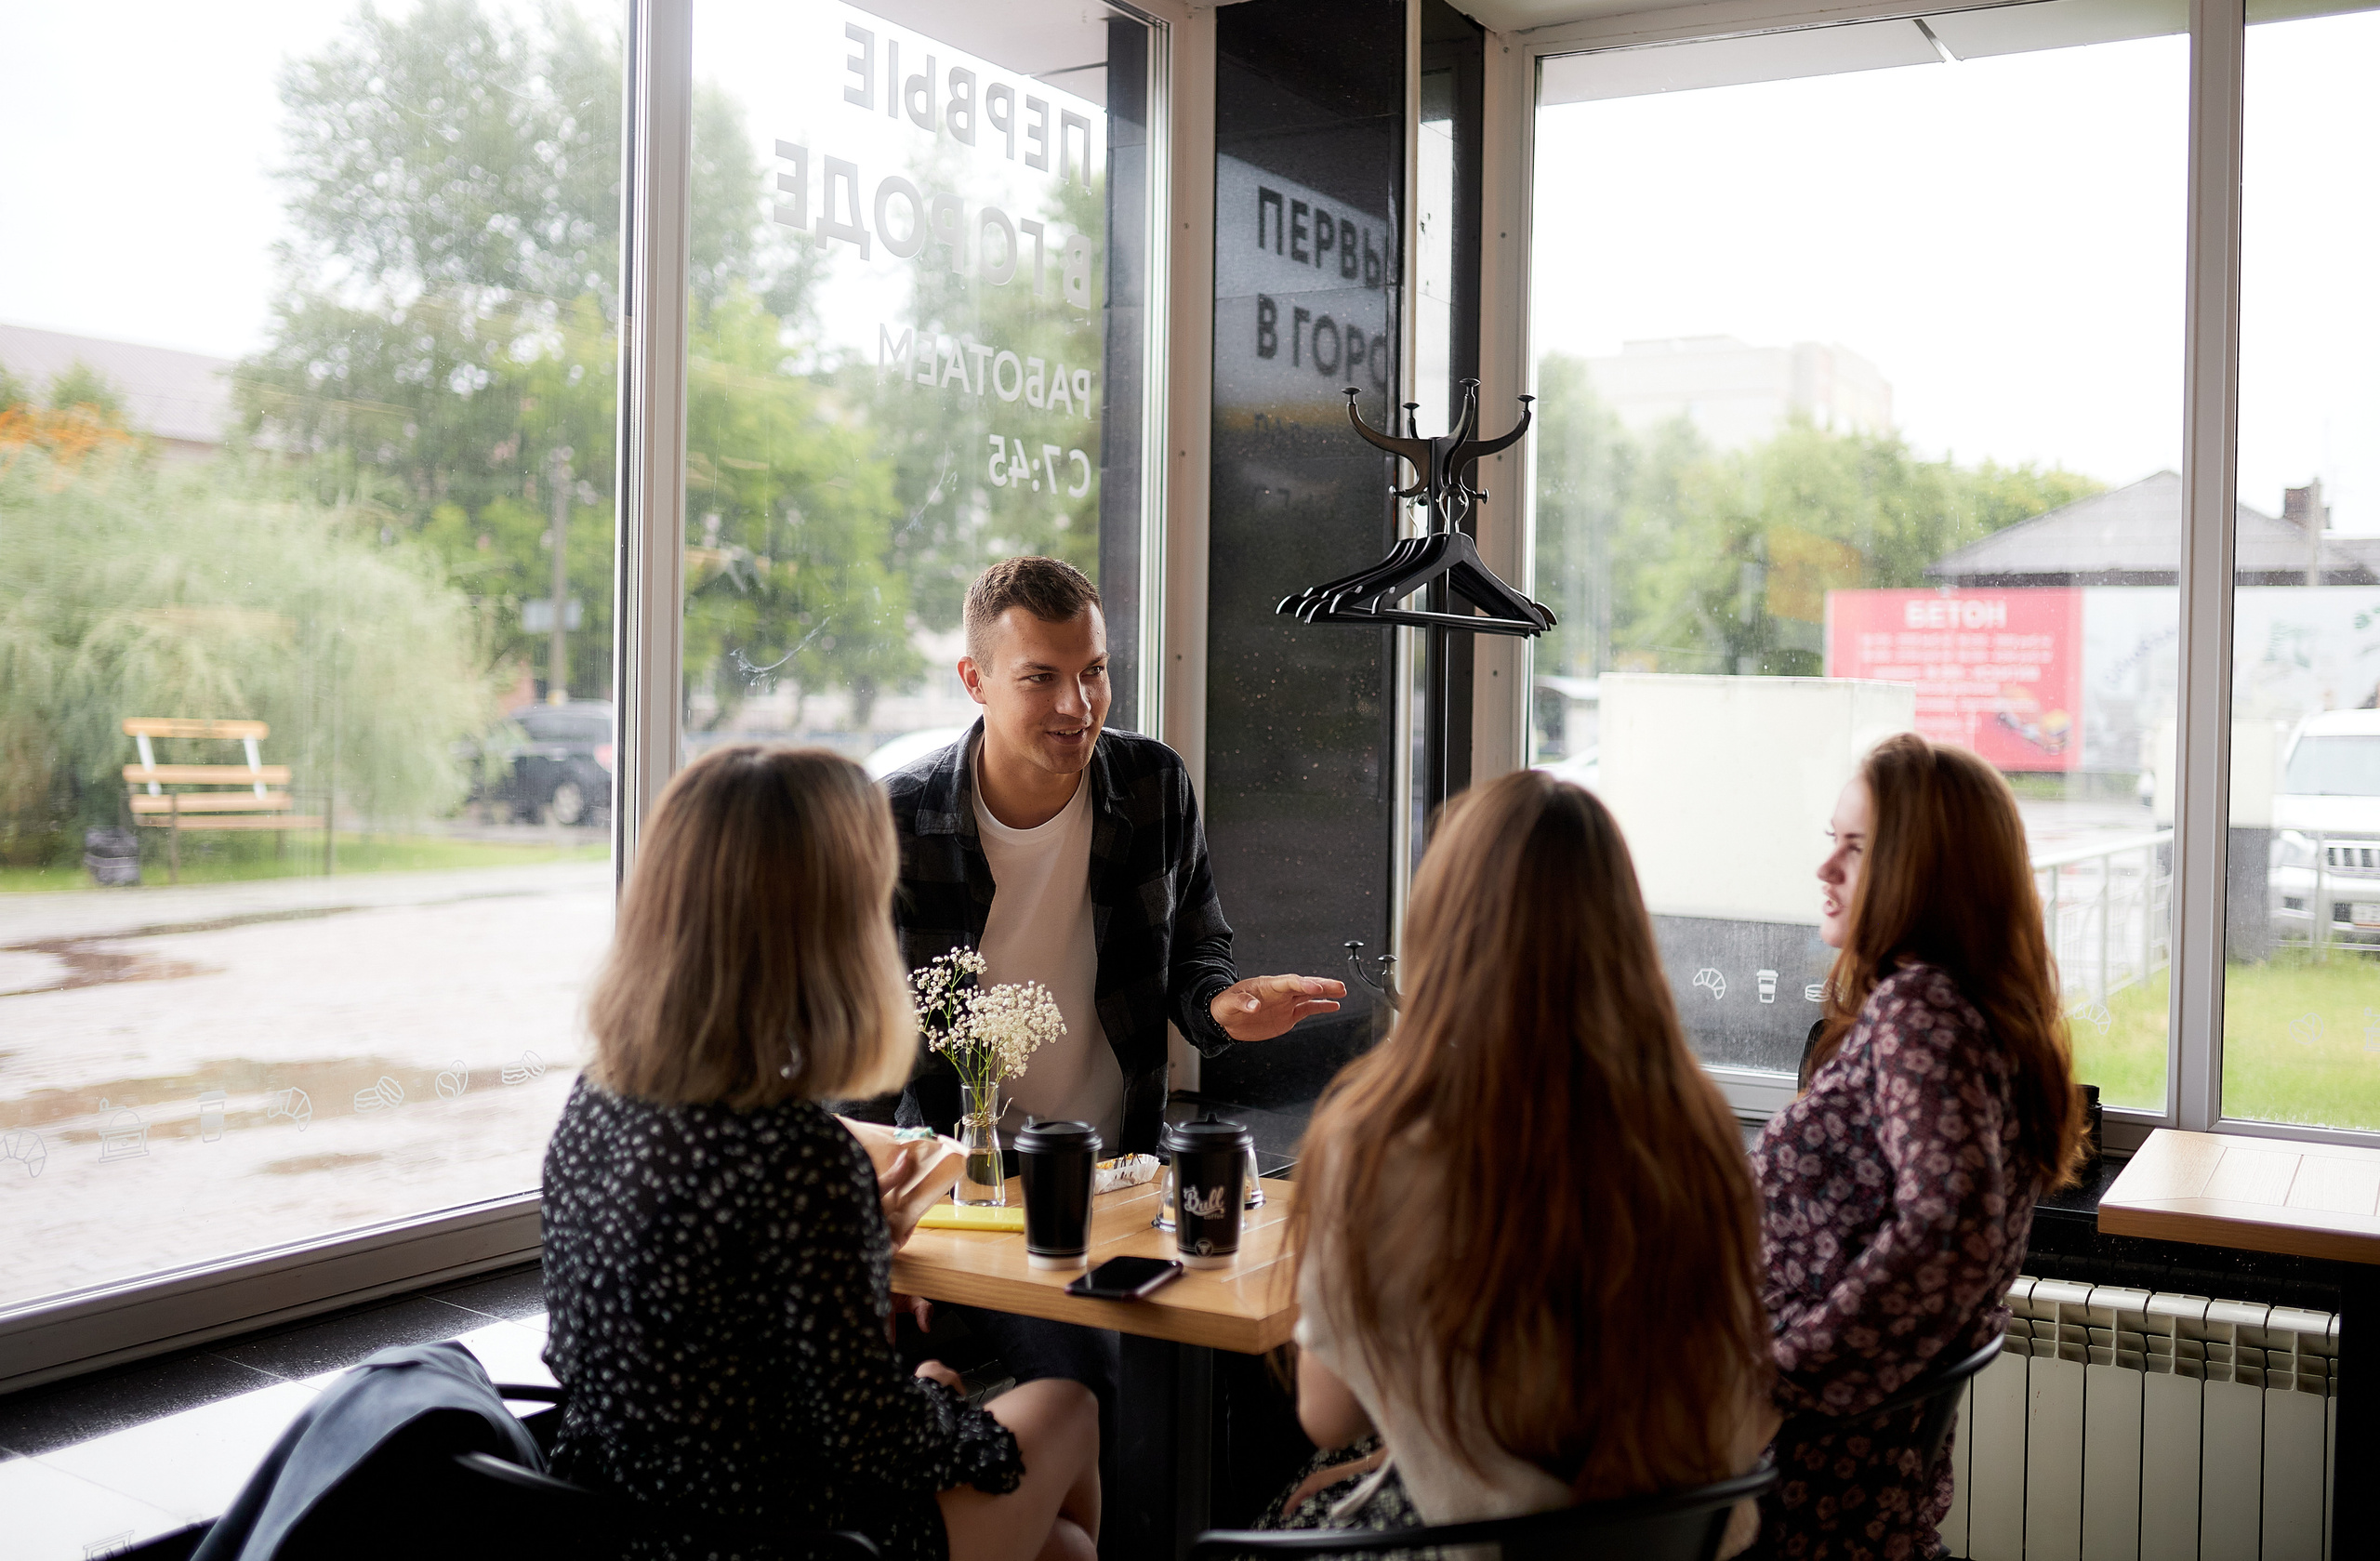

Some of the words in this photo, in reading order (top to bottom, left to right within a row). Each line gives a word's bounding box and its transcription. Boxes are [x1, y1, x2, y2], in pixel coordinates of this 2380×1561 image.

[1259, 186, 1381, 290] ПЕРВЫ
[1293, 306, 1386, 391] ГОРО
[1183, 1185, 1225, 1216] Bull
